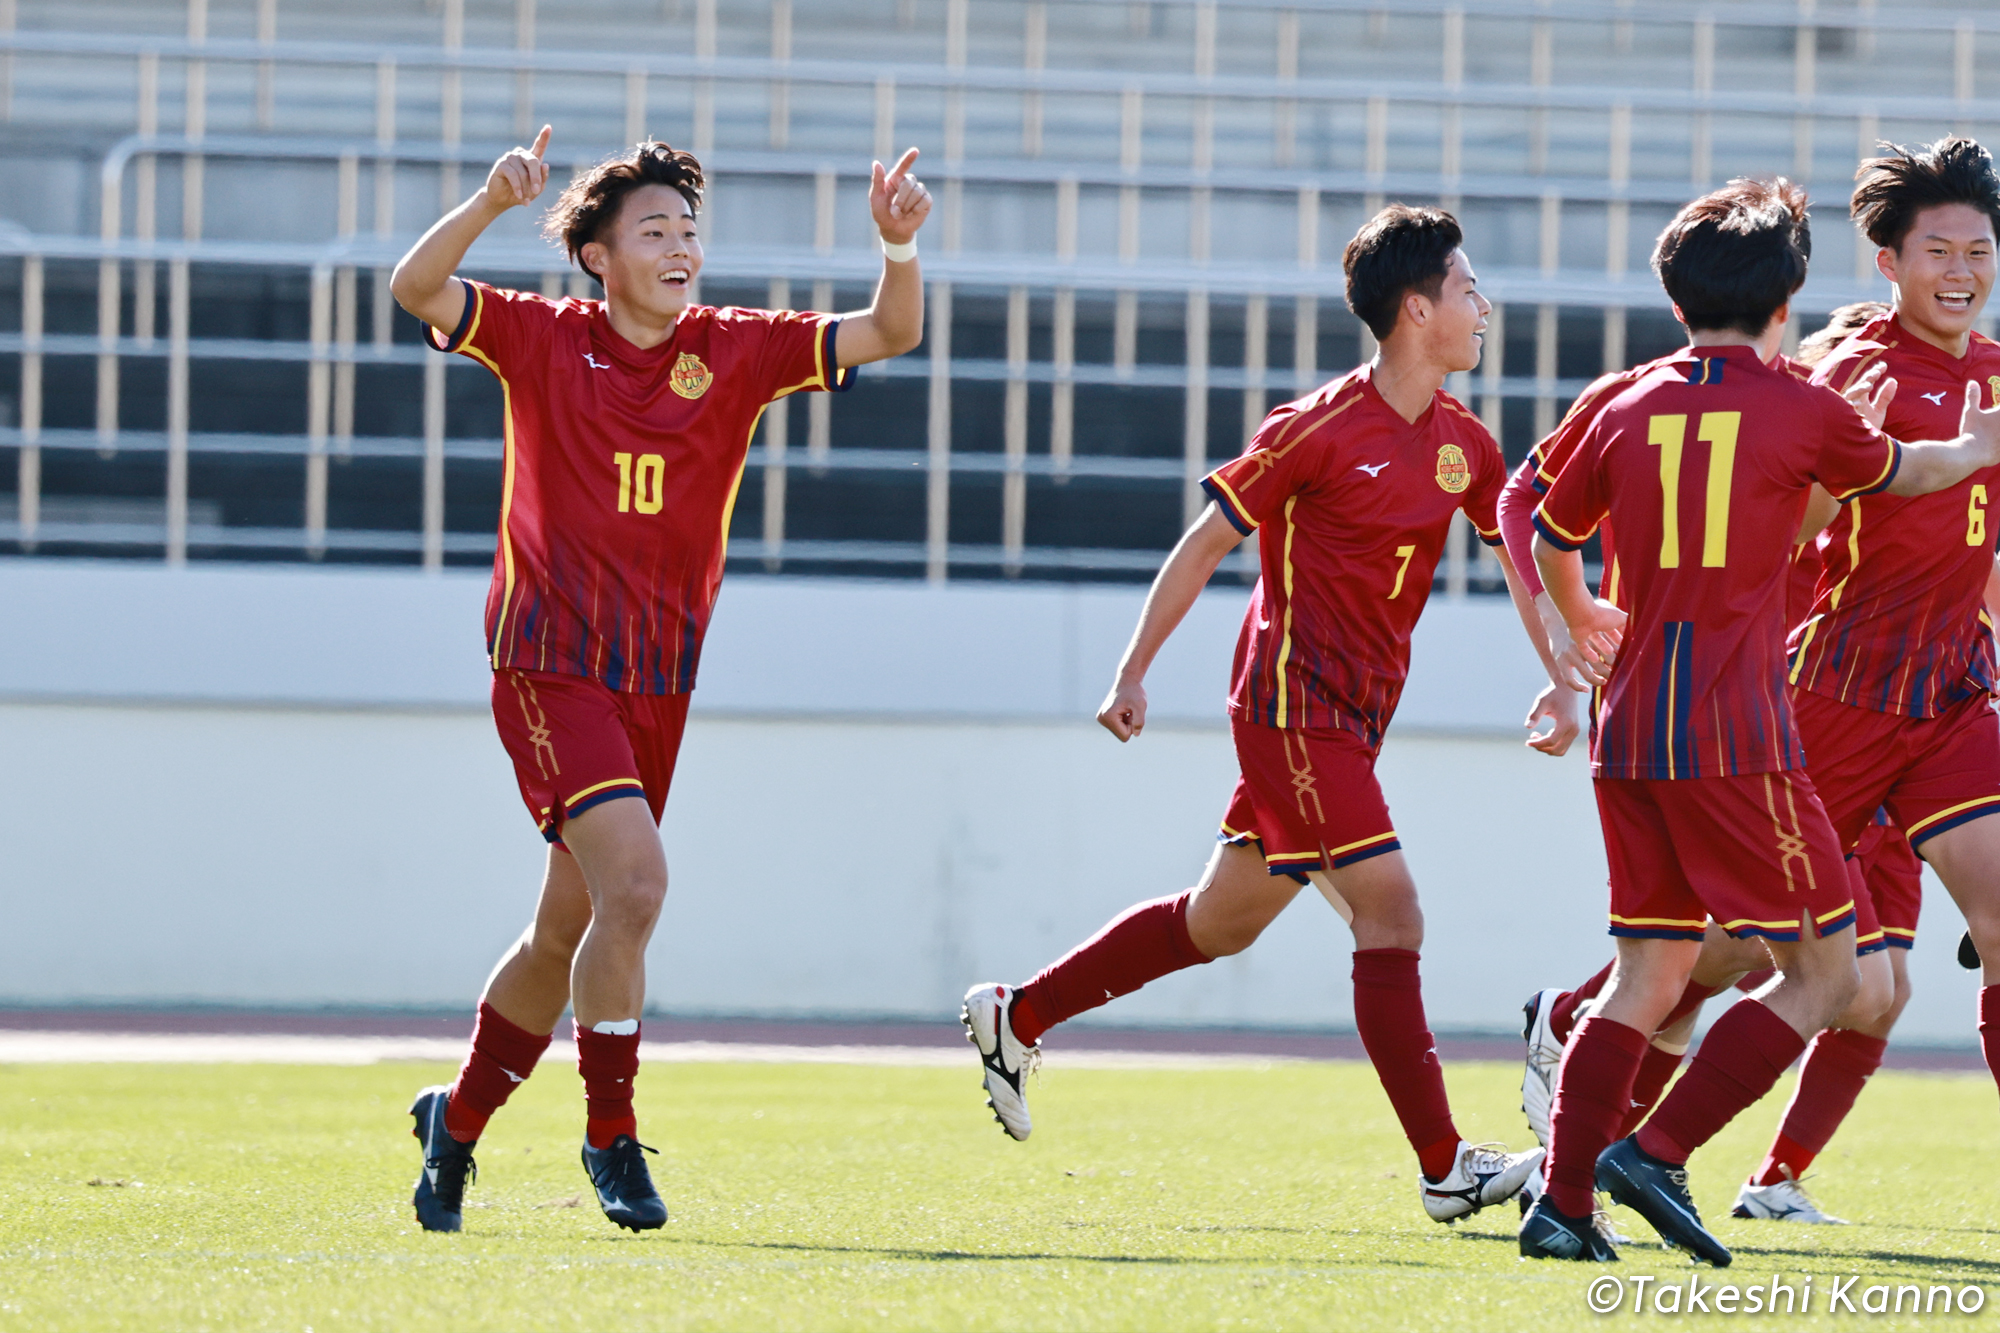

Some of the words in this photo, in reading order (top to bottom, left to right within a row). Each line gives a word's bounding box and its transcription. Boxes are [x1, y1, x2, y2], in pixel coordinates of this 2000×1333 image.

[613, 452, 666, 515] 10
[1648, 411, 1741, 569] 11
[1966, 484, 1988, 547] 6
[1388, 545, 1416, 600] 7
